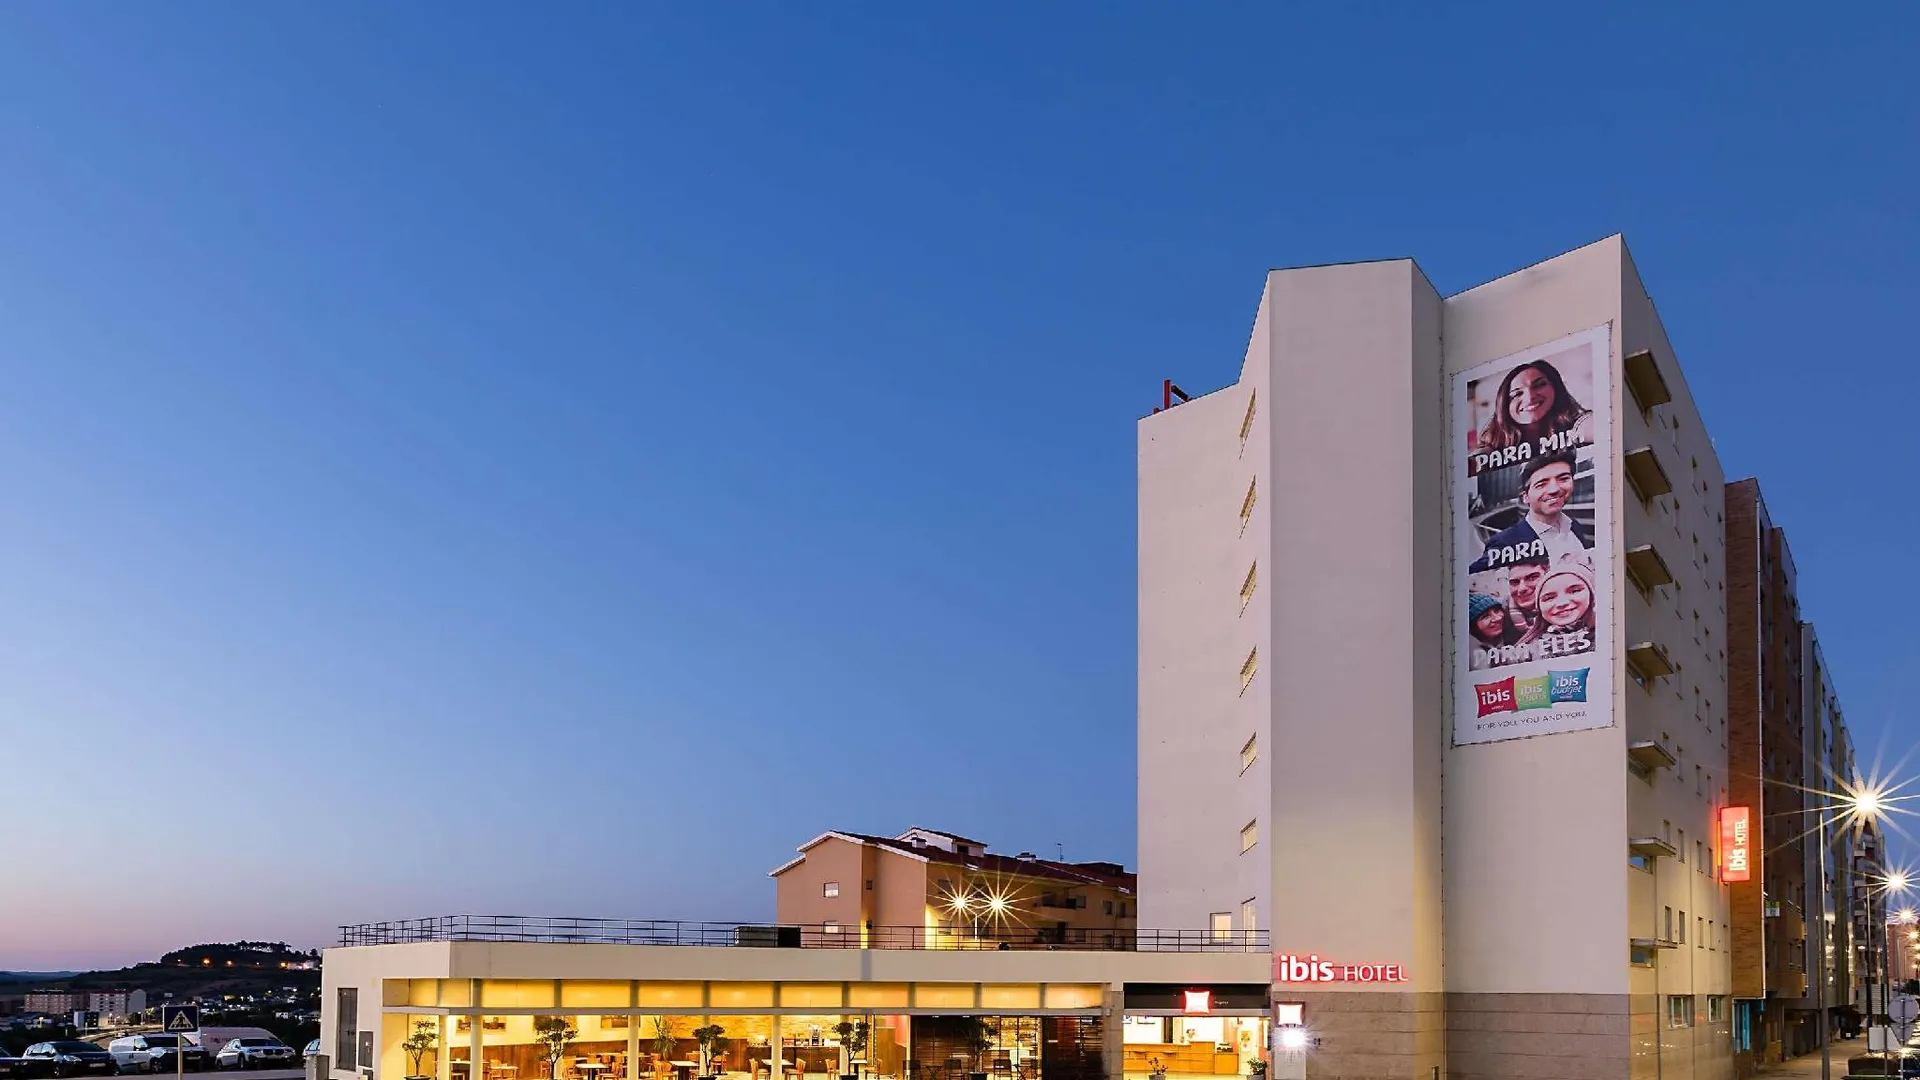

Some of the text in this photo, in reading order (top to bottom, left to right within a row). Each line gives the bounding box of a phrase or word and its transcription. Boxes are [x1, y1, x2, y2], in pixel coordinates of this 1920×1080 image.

[1475, 428, 1585, 473] PARA MIM
[1487, 539, 1545, 567] PARA
[1473, 642, 1531, 668] PARA
[1520, 684, 1543, 696] ibis
[1551, 685, 1582, 696] budget
[1556, 676, 1579, 687] ibis
[1481, 688, 1511, 705] ibis
[1477, 722, 1496, 730] FOR
[1542, 713, 1563, 722] AND
[1734, 819, 1746, 846] HOTEL
[1280, 955, 1409, 981] ibis HOTEL
